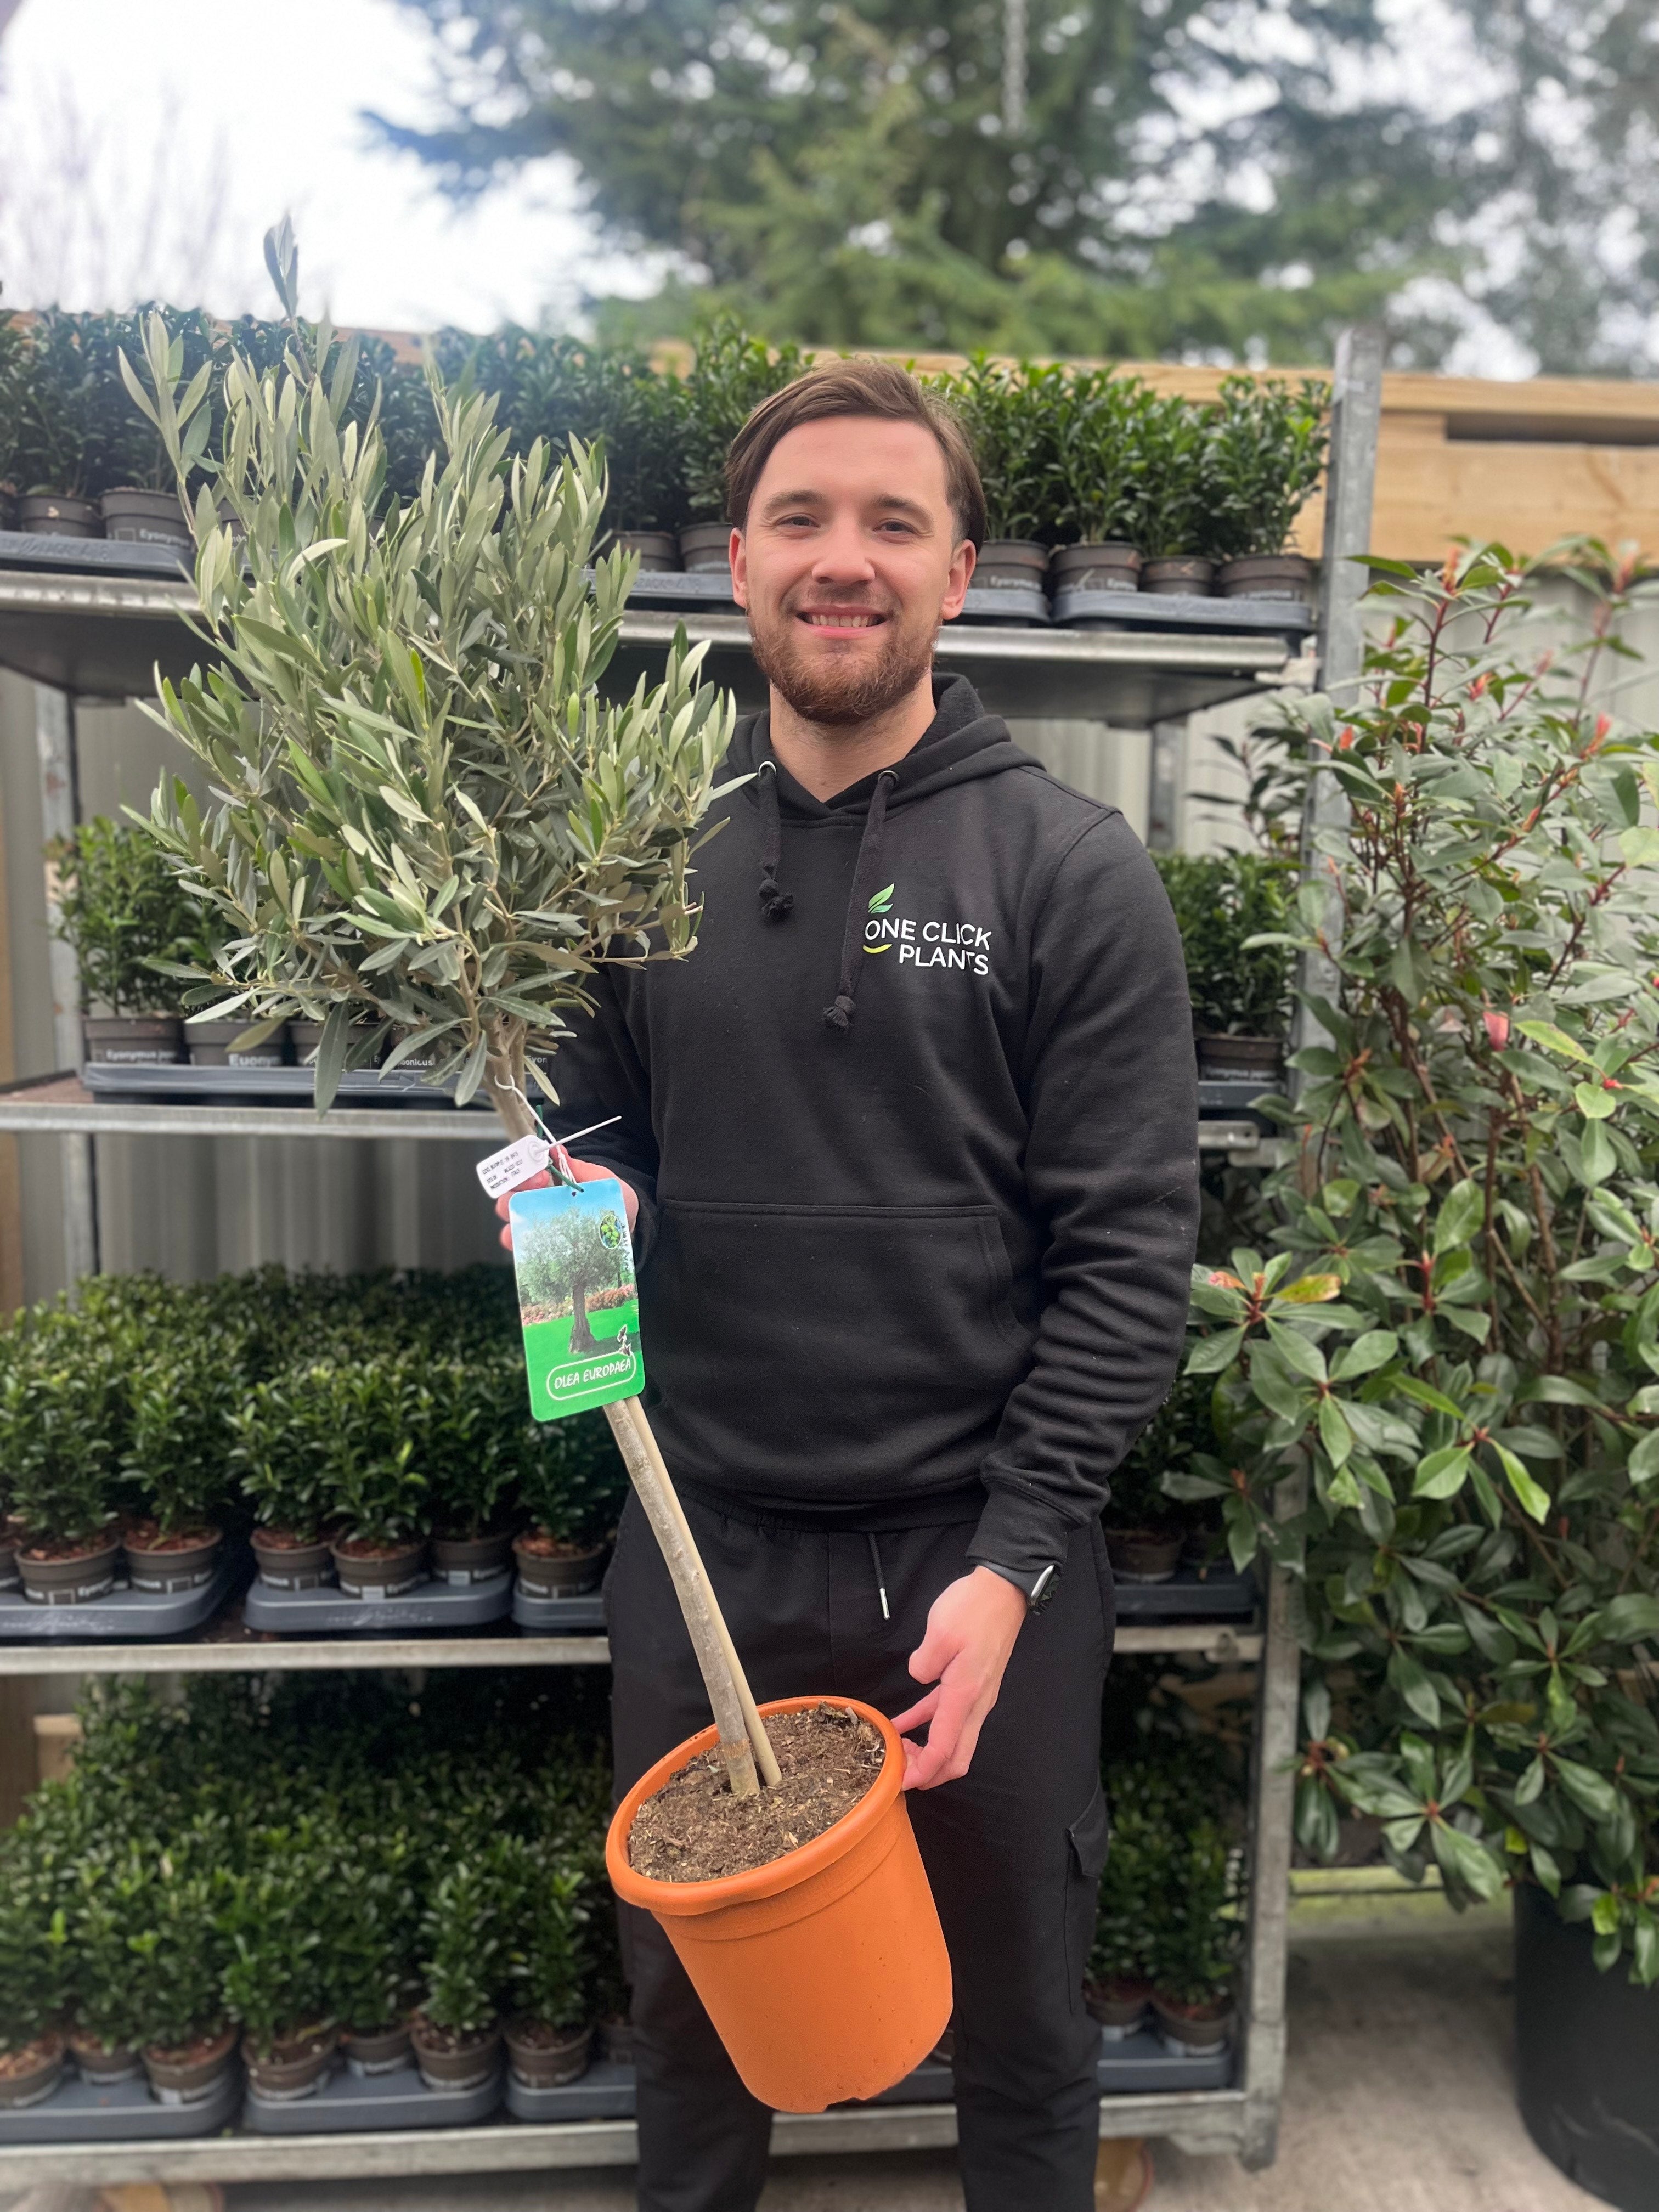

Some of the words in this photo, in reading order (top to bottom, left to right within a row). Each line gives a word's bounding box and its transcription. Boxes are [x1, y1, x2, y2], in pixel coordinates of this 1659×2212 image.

[865, 918, 917, 941] ONE
[922, 921, 992, 951] CLICK
[899, 944, 989, 975] PLANTS
[554, 1372, 580, 1390] OLEA
[583, 1358, 631, 1383] EUROPAEA
